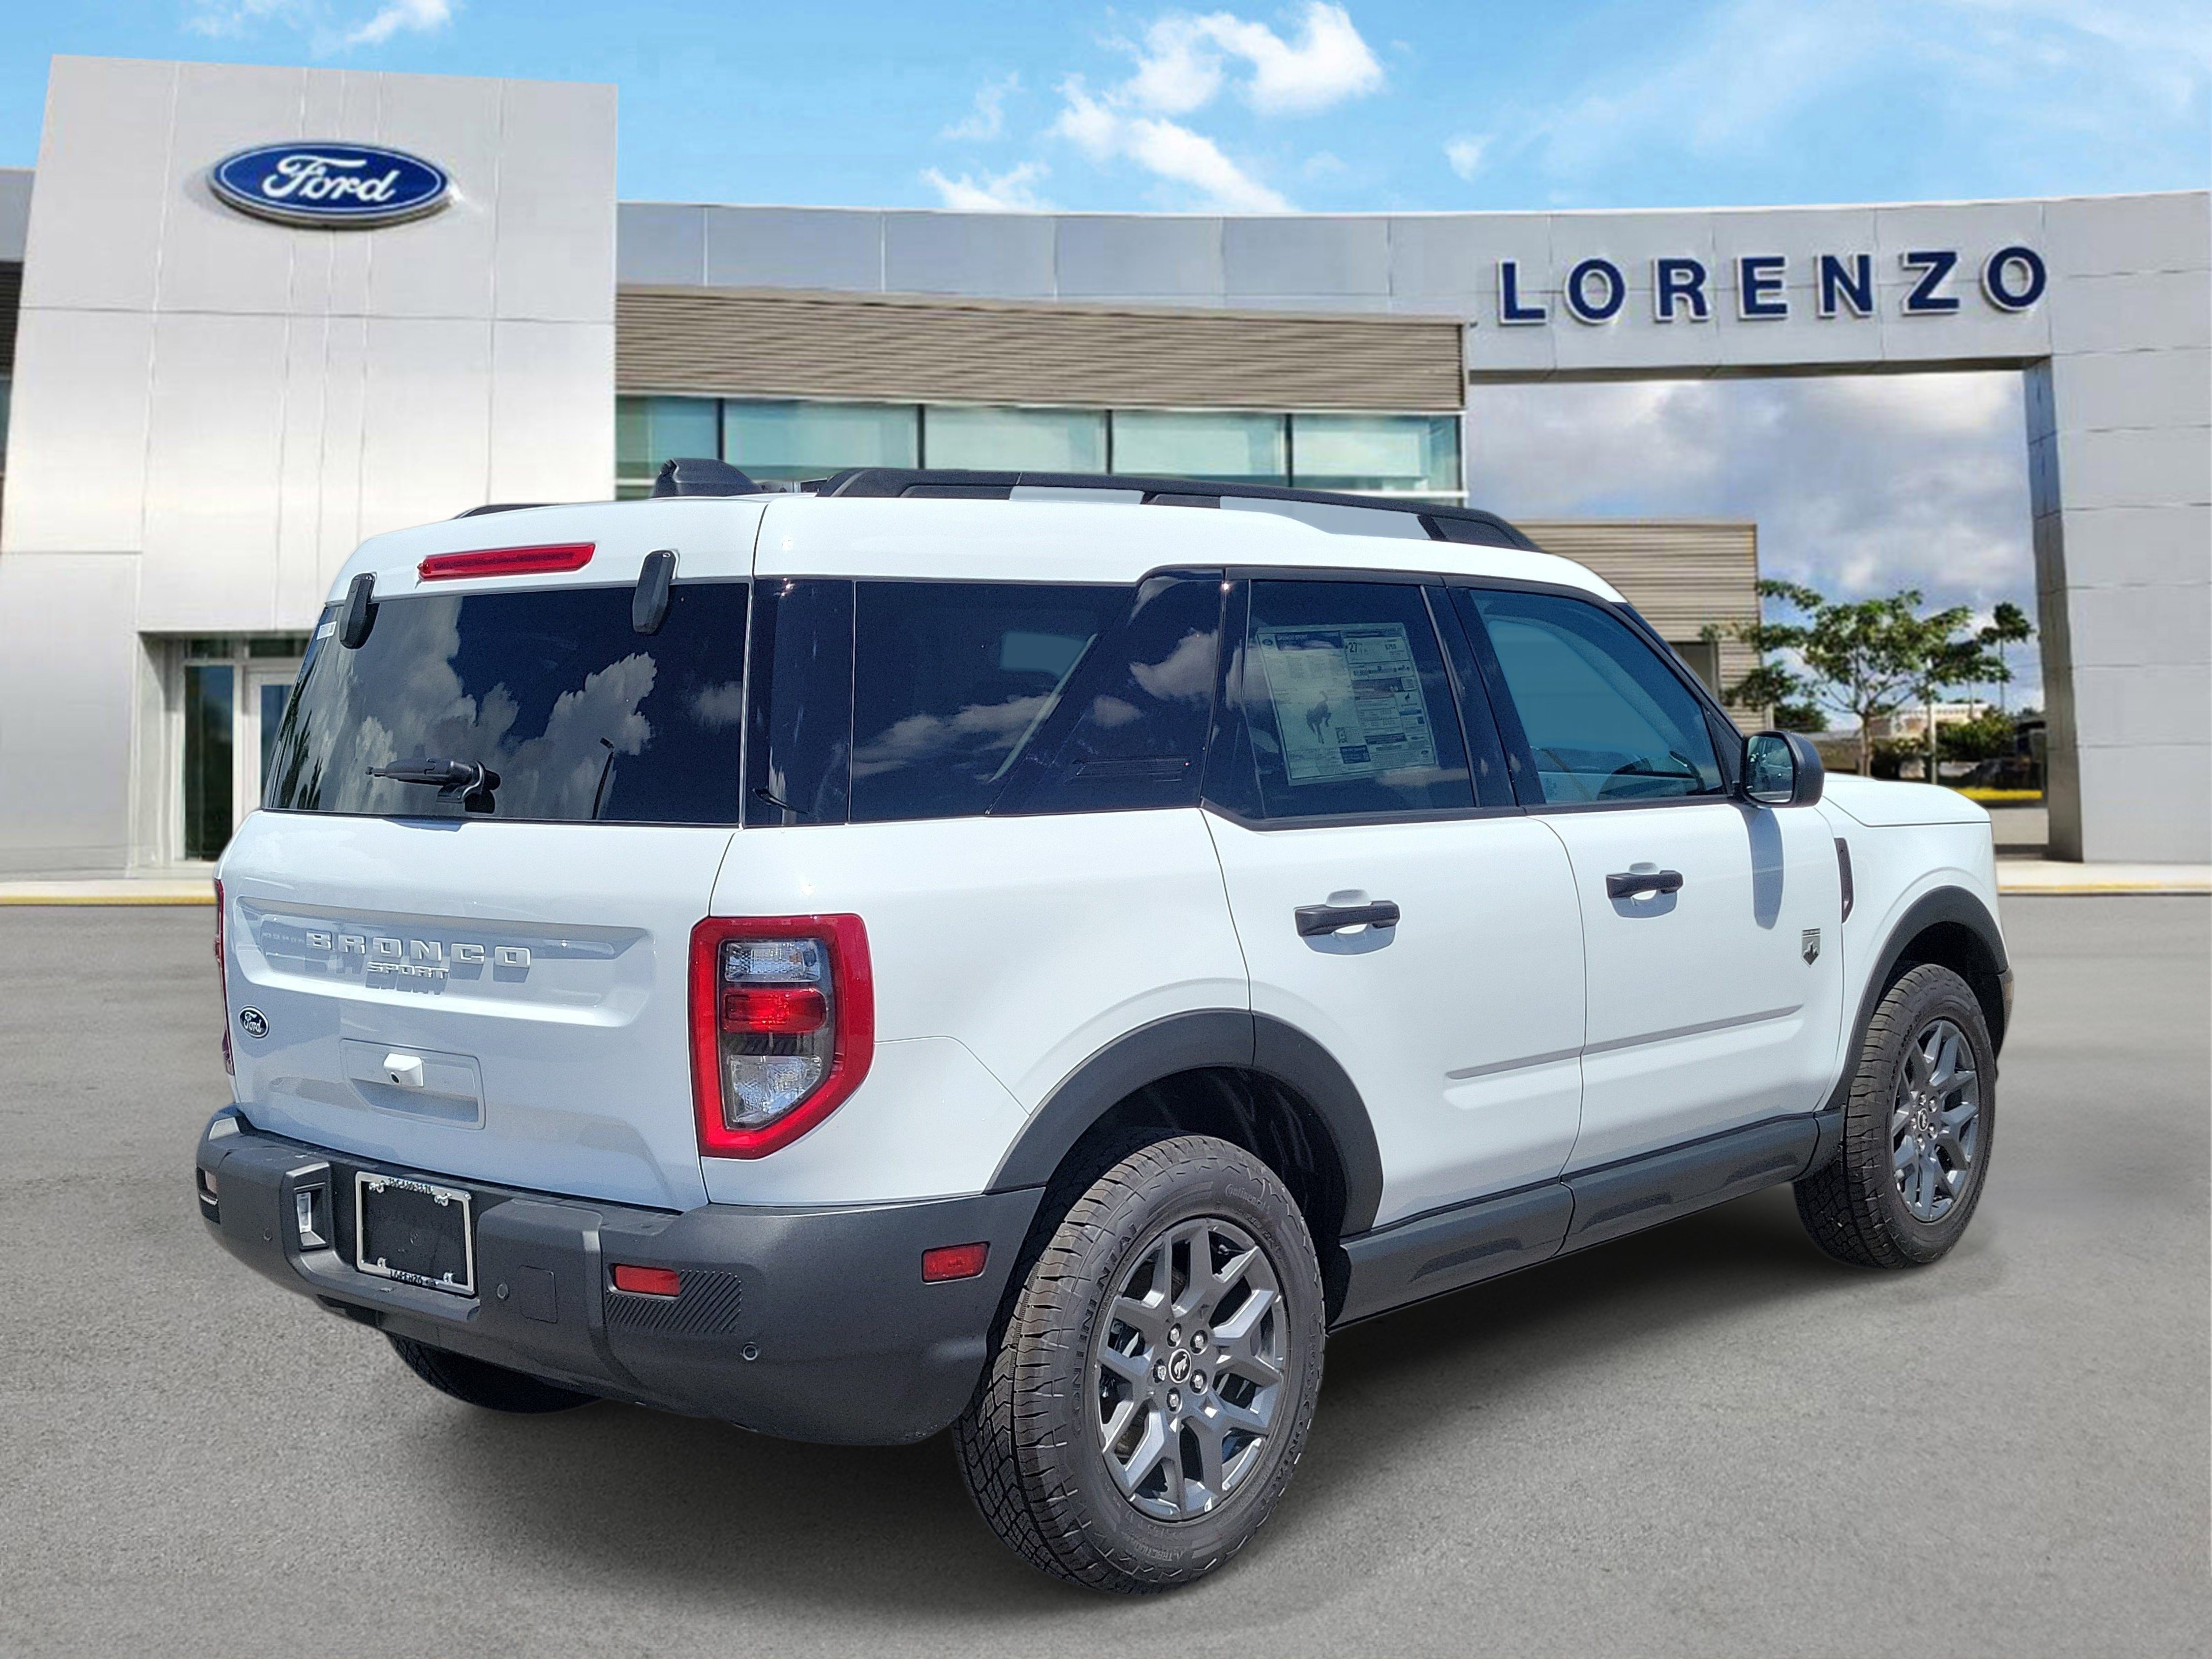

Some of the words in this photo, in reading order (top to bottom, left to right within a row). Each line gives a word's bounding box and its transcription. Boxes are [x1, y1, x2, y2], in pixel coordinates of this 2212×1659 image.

[262, 154, 401, 202] Ford
[1498, 247, 2047, 324] LORENZO
[306, 931, 532, 967] BRONCO
[366, 961, 450, 980] SPORT
[243, 1011, 264, 1033] Ford
